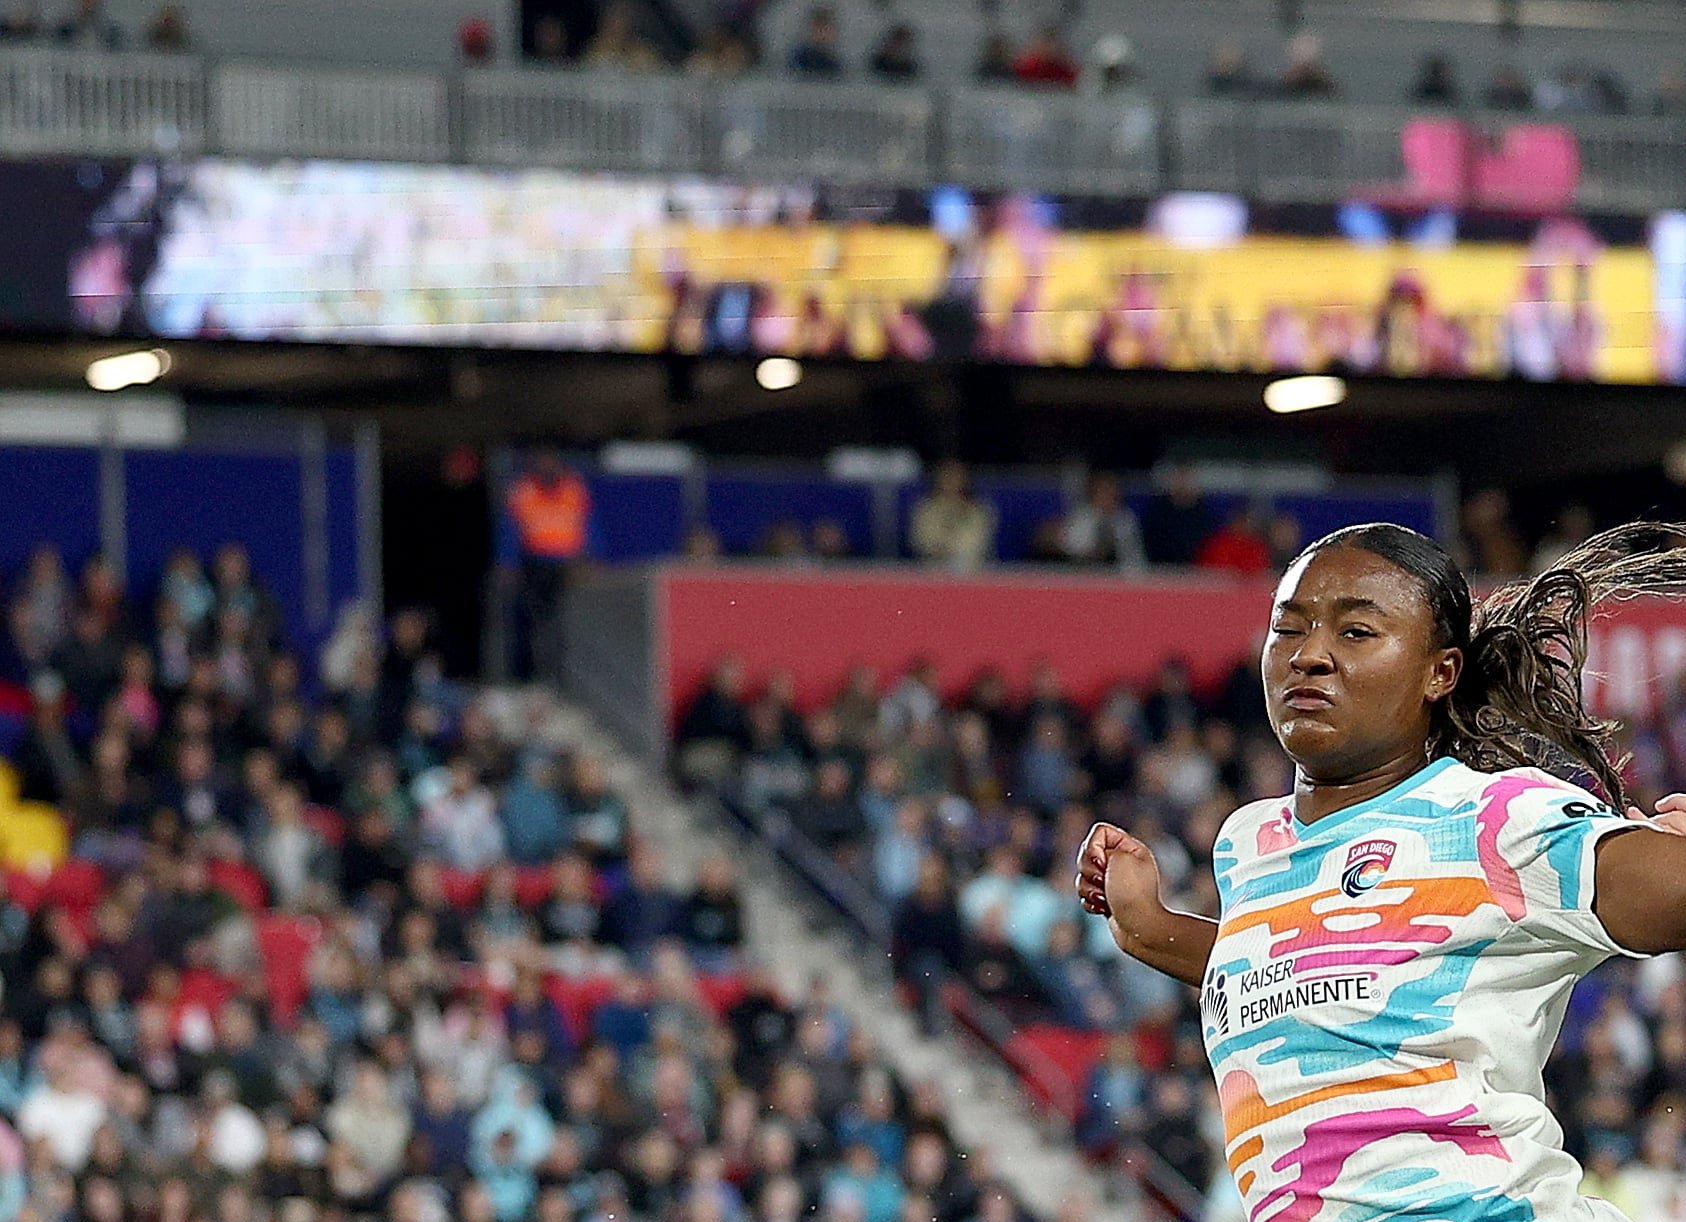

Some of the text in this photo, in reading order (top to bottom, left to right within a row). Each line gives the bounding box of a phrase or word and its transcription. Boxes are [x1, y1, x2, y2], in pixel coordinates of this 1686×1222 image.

[1349, 842, 1394, 861] SAN DIEGO
[1240, 958, 1294, 996] KAISER
[1240, 977, 1371, 1028] PERMANENTE
